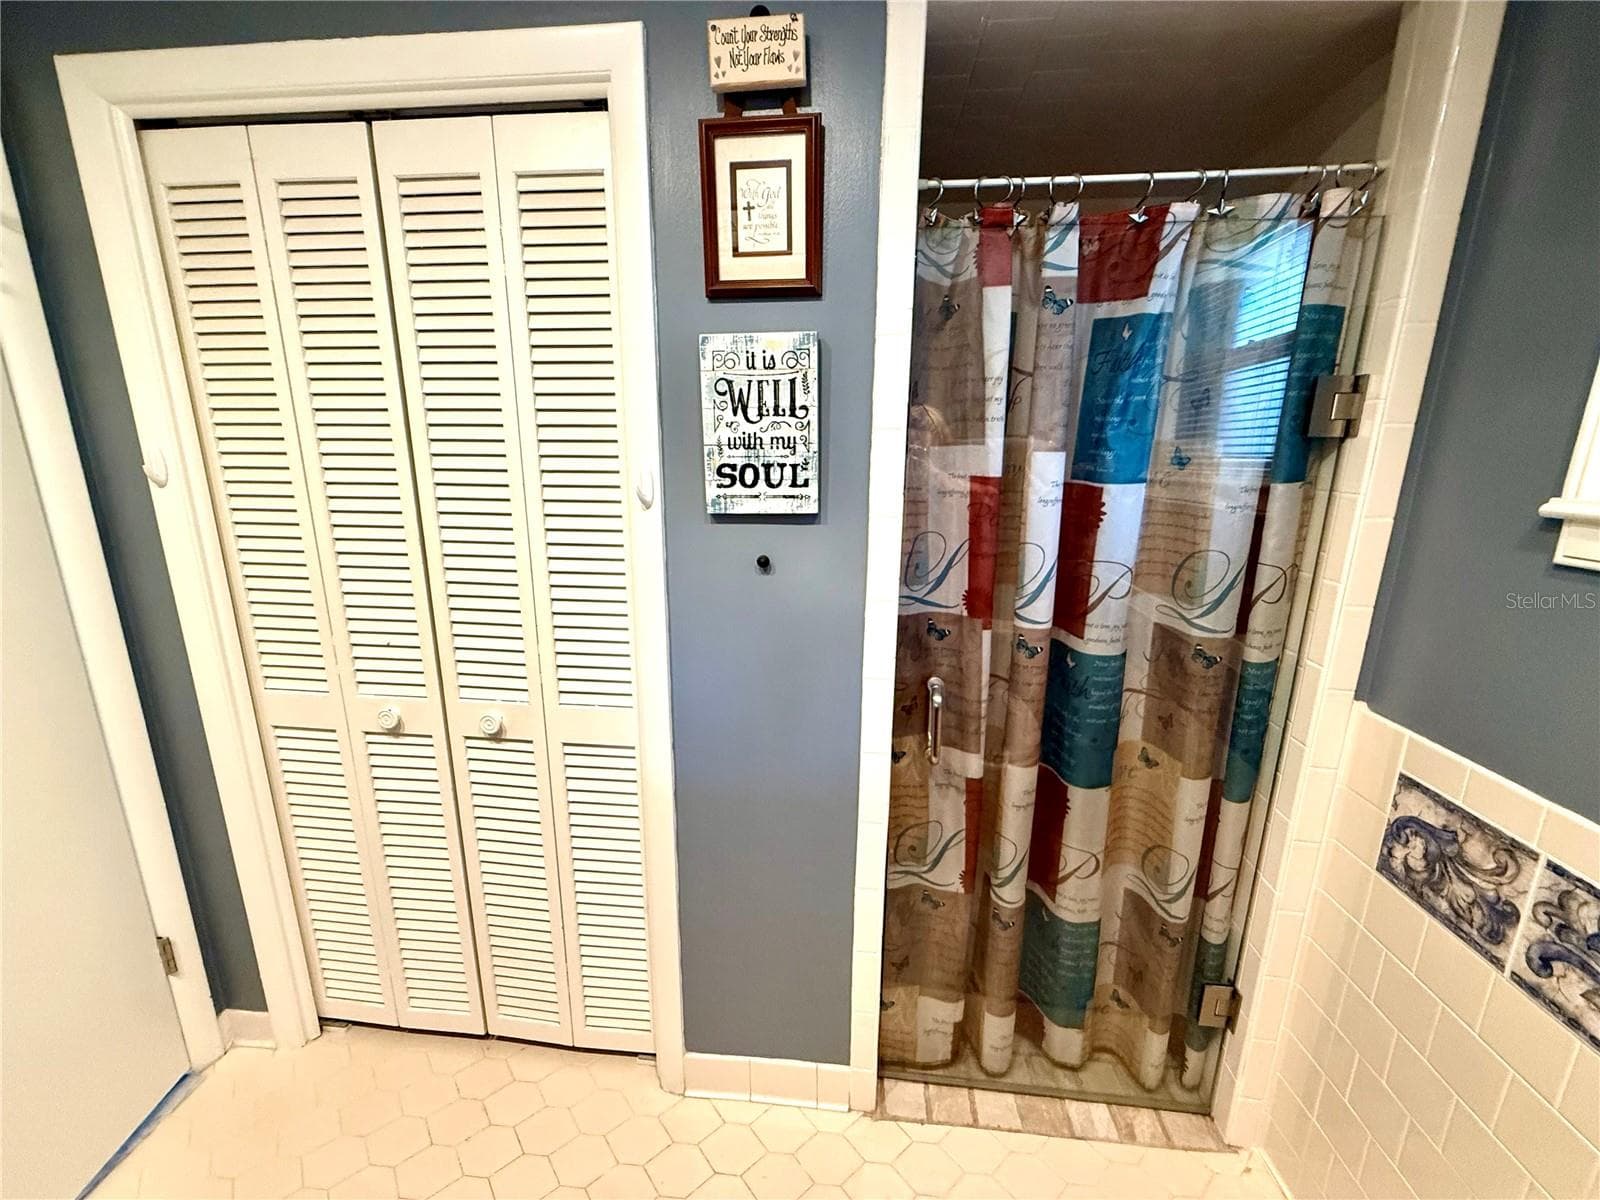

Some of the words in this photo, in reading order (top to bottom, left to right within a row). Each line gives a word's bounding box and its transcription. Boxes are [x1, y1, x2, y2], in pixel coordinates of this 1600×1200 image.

[713, 26, 739, 46] Count
[759, 22, 798, 46] Strengths
[729, 47, 743, 68] Not
[742, 46, 762, 72] Your
[763, 46, 785, 65] Flaws
[745, 350, 757, 370] it
[762, 350, 776, 370] is
[714, 377, 810, 424] WELL
[727, 431, 765, 451] with
[770, 435, 797, 456] my
[715, 462, 810, 489] SOUL
